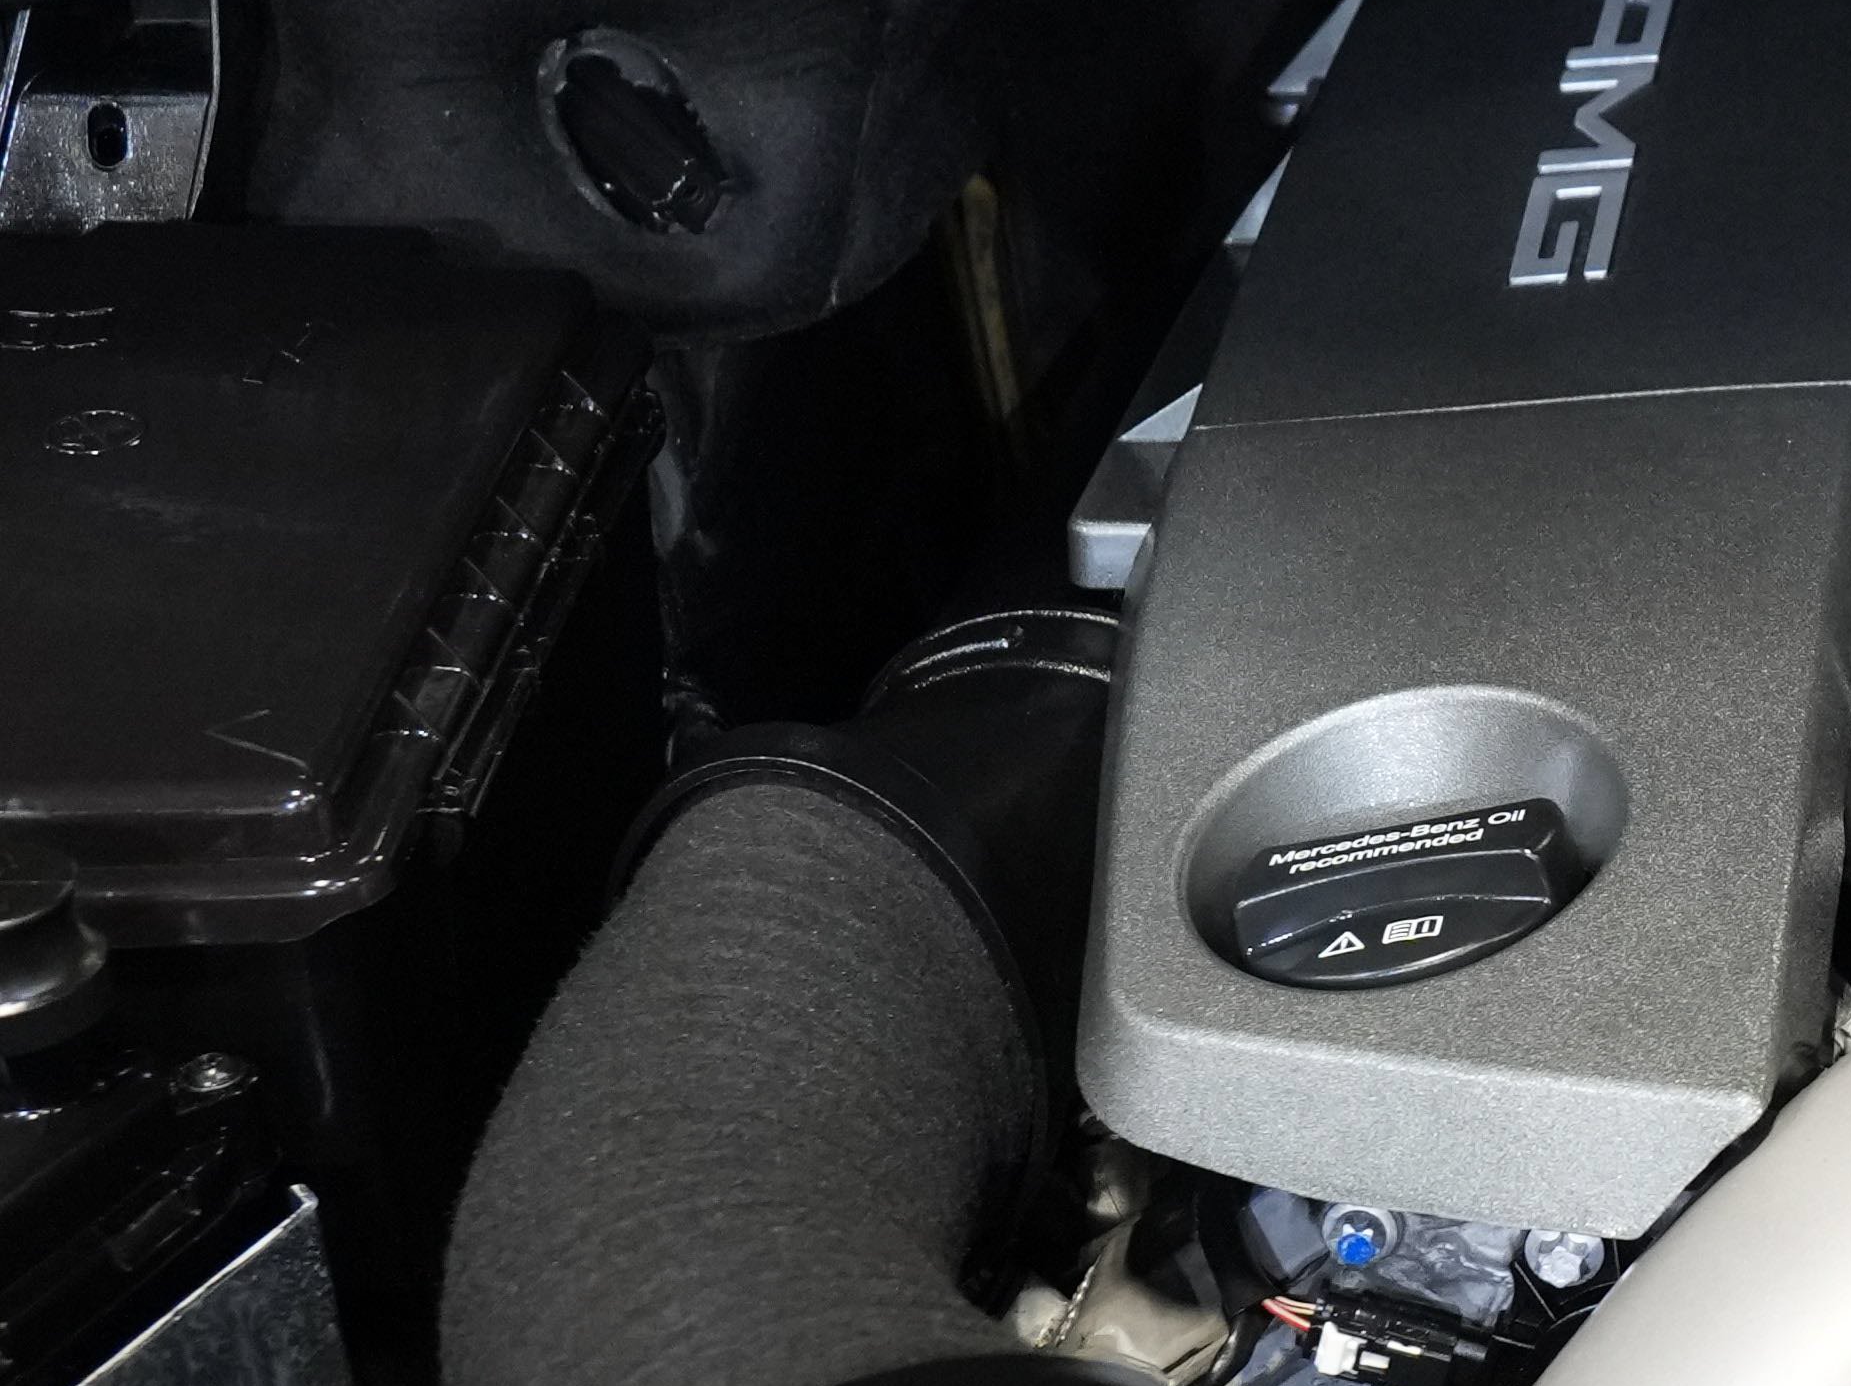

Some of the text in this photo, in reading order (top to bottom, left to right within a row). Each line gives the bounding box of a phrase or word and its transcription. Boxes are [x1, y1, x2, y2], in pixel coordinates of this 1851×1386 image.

[1268, 809, 1526, 866] Mercedes-Benz Oil
[1289, 828, 1484, 874] recommended
